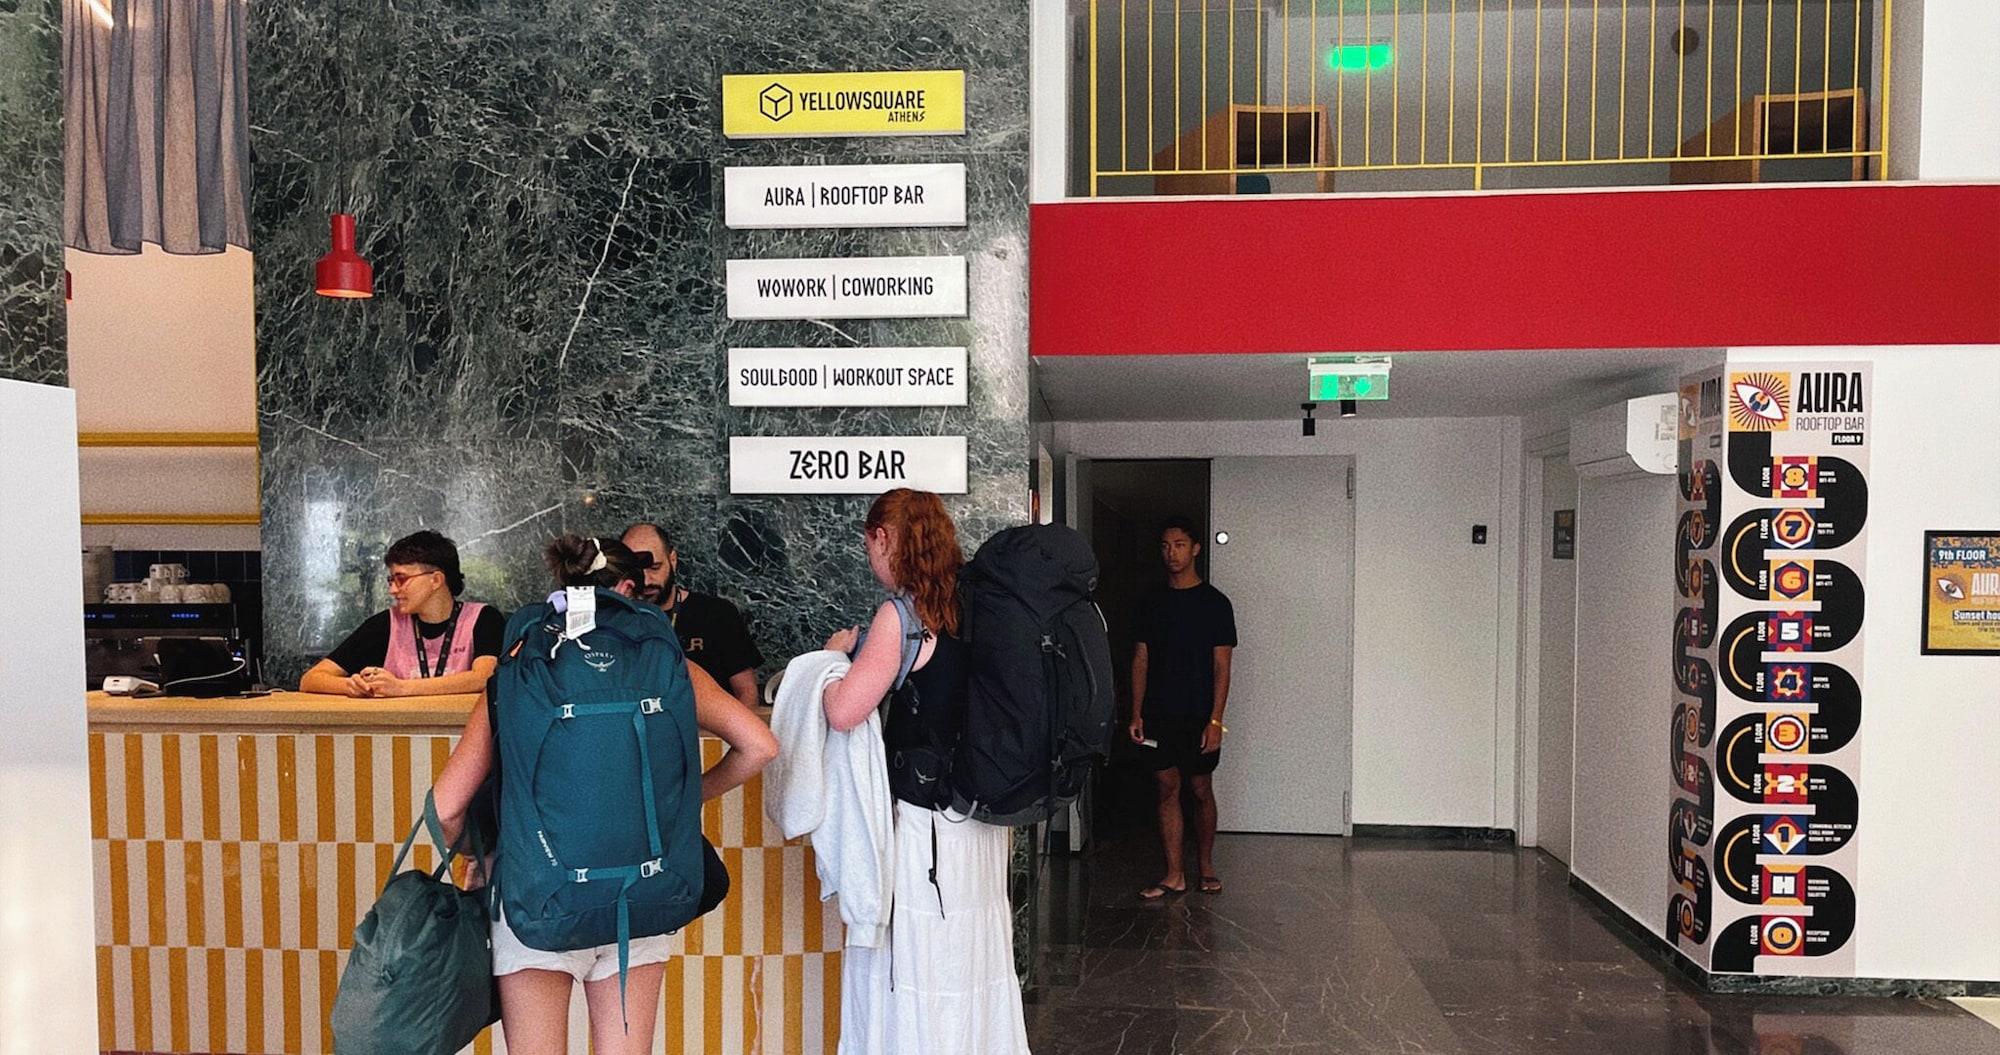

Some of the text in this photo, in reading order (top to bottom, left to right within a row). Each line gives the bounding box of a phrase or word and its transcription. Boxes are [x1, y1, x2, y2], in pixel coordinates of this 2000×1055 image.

[799, 90, 925, 111] YELLOWSQUARE
[888, 111, 925, 122] ATHENS
[764, 185, 924, 206] AURA ROOFTOP BAR
[757, 277, 933, 297] WOWORK COWORKING
[741, 368, 954, 387] SOULGOOD WORKOUT SPACE
[1796, 372, 1863, 413] AURA
[1796, 417, 1865, 431] ROOFTOP BAR
[1834, 435, 1855, 443] FLOOR
[790, 450, 906, 479] ZERO BAR
[1762, 467, 1770, 488] FLOOR
[1784, 467, 1806, 488] 8
[1760, 519, 1768, 539] FLOOR
[1785, 521, 1802, 537] 7
[1938, 550, 1986, 560] 9th FLOOR
[1759, 570, 1767, 590] FLOOR
[1782, 571, 1802, 590] 6
[1971, 573, 2000, 596] AUR
[1953, 610, 1985, 620] Sunset
[1757, 621, 1766, 641] FLOOR
[1781, 622, 1799, 640] 5
[1756, 672, 1764, 692] FLOOR
[1780, 674, 1798, 691] 4
[1755, 723, 1763, 743] FLOOR
[1778, 724, 1797, 743] 3
[1753, 774, 1761, 794] FLOOR
[1777, 775, 1795, 793] 2
[1752, 824, 1760, 844] FLOOR
[1778, 826, 1789, 843] 1
[1751, 875, 1759, 895] FLOOR
[1772, 876, 1795, 895] H
[1750, 925, 1758, 945] FLOOR
